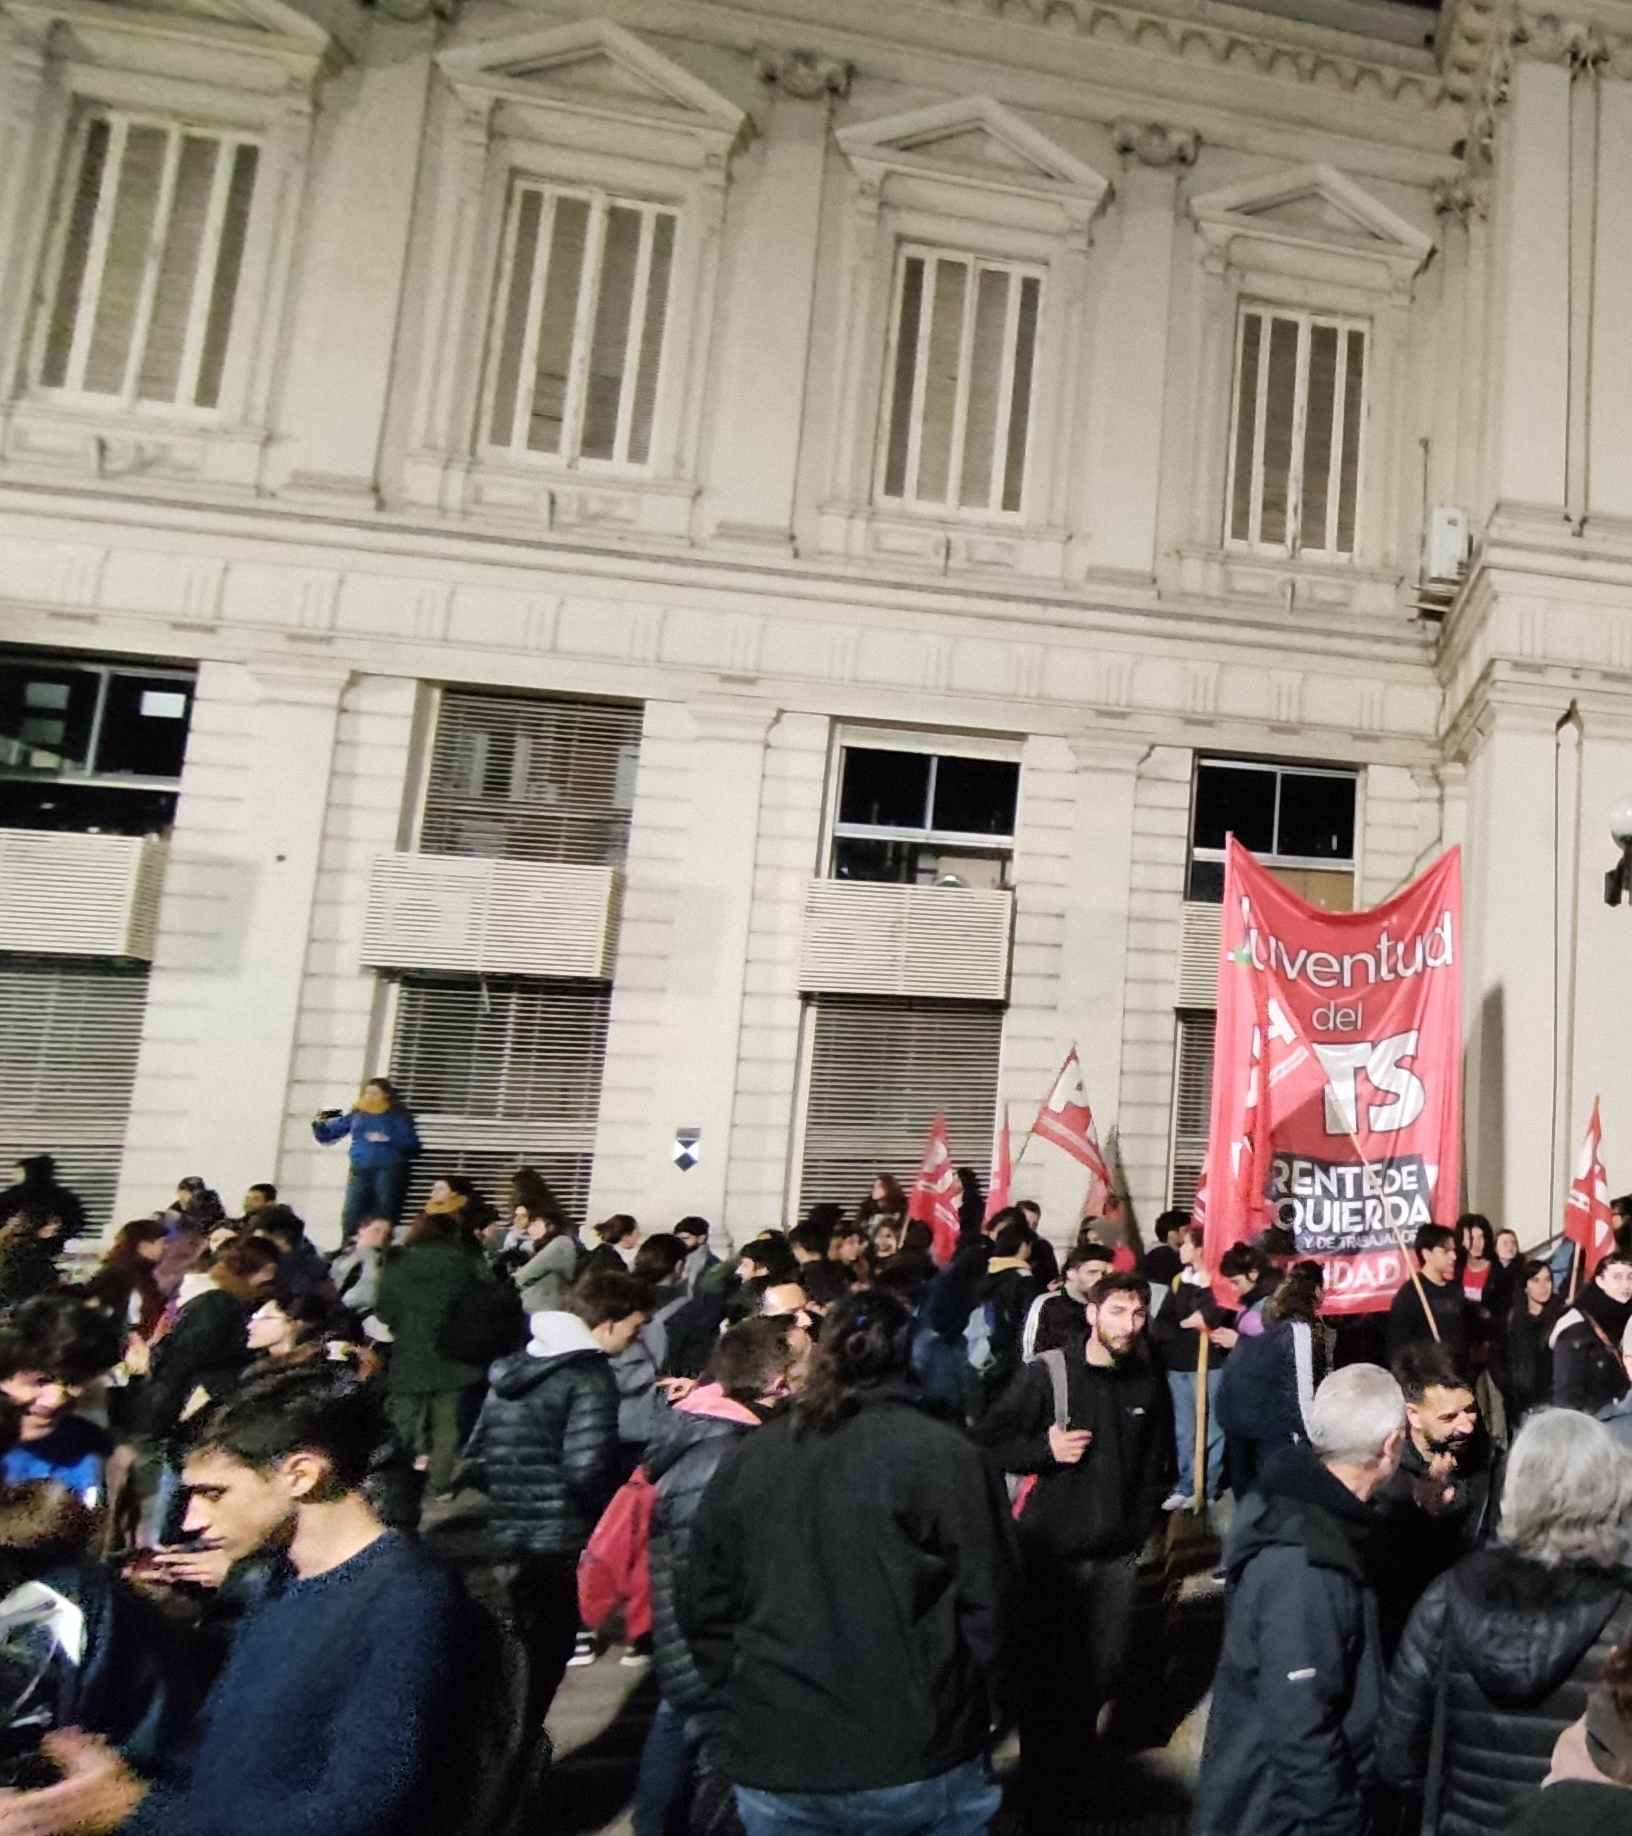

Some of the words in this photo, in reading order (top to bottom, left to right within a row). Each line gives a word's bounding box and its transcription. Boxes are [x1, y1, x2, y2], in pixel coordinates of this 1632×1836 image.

[1311, 1000, 1363, 1032] del
[1311, 1029, 1426, 1136] TS
[1272, 1158, 1383, 1199] RENTE
[1384, 1164, 1419, 1195] DE
[1273, 1193, 1432, 1235] QUIERDA
[1322, 1256, 1400, 1290] IDAD
